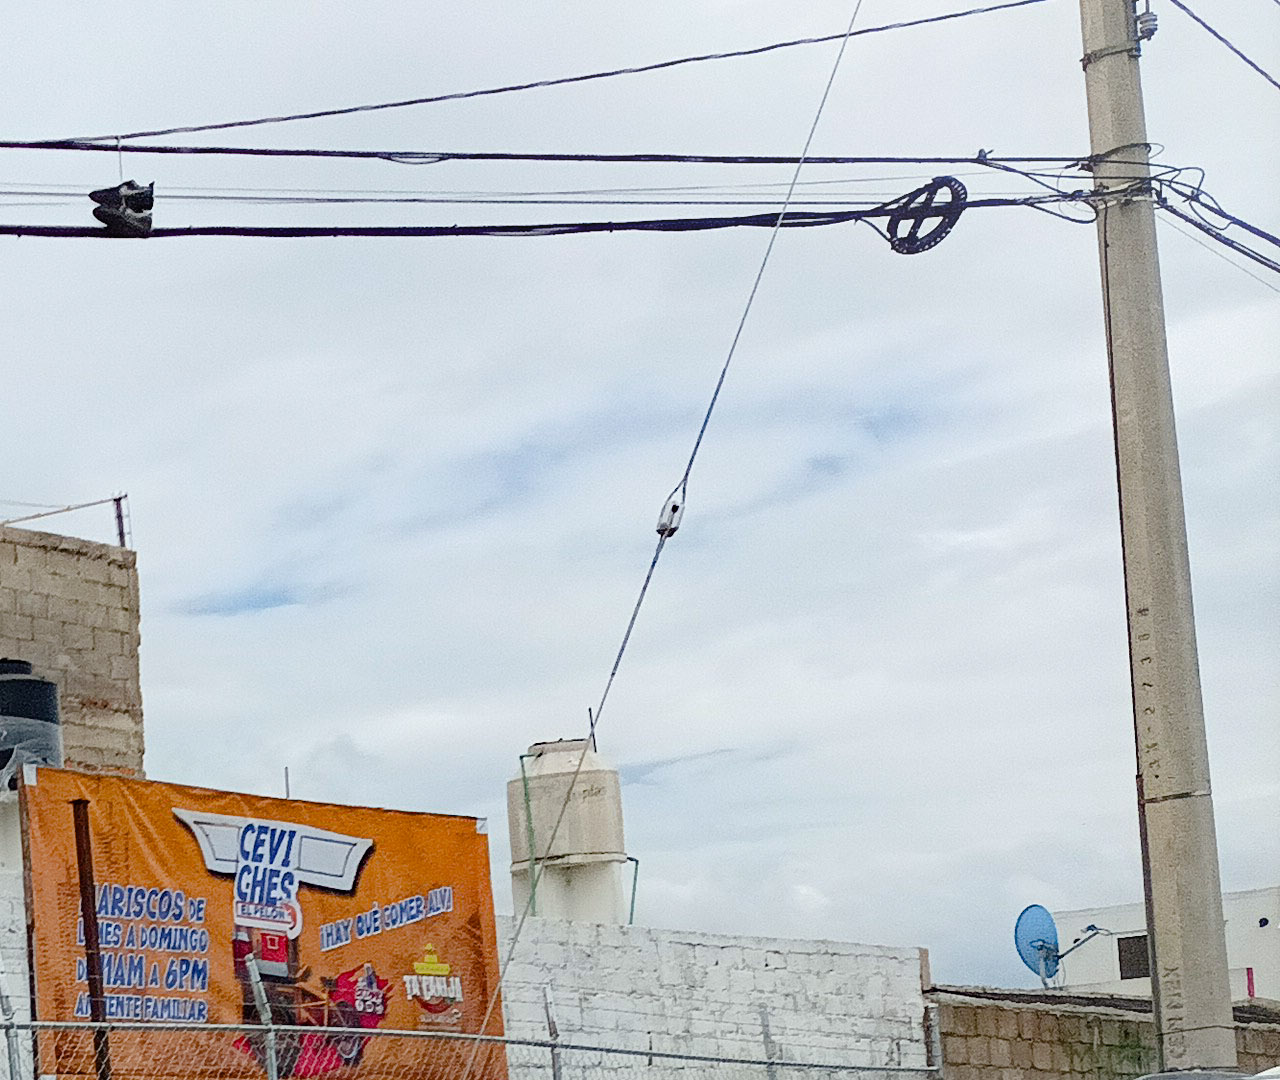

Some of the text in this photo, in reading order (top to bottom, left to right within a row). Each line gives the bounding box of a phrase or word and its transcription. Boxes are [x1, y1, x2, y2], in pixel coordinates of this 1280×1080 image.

[240, 823, 297, 868] CEVI
[81, 884, 205, 922] ARISCOS DE
[237, 865, 295, 906] CHES
[383, 896, 424, 930] COMER
[77, 917, 208, 952] LNES A DOMINGO
[149, 963, 159, 987] A
[165, 957, 207, 991] 6PM
[143, 996, 208, 1022] FAMILIAR
